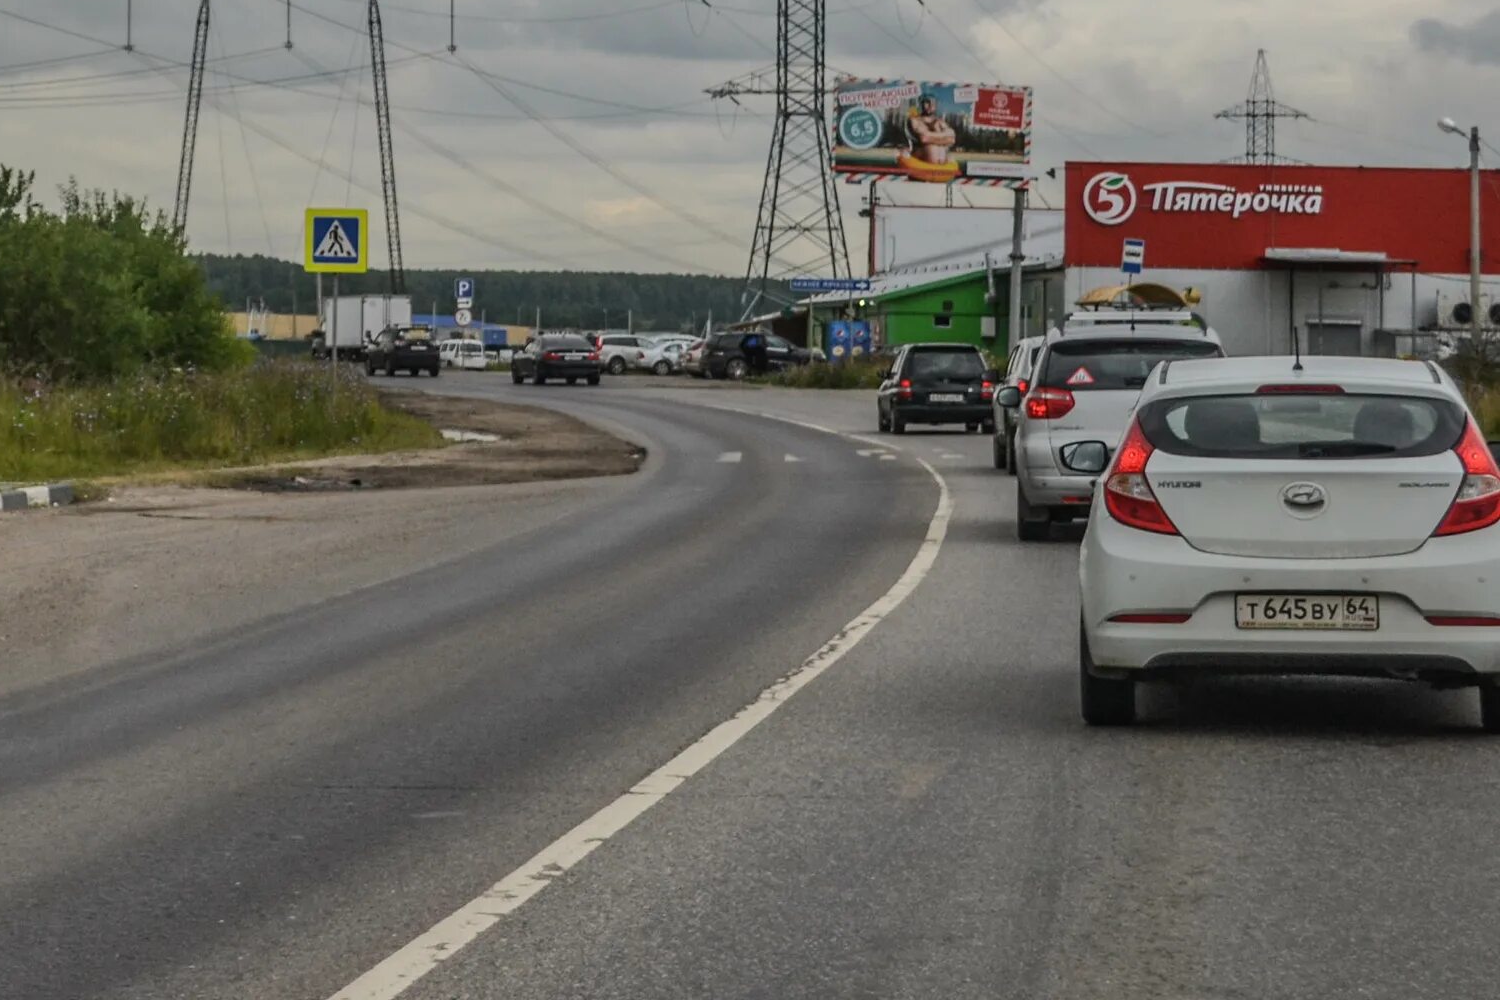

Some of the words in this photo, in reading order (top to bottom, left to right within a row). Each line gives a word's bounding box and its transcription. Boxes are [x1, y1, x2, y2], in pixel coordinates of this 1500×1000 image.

[851, 120, 874, 137] 6,5
[1259, 184, 1323, 193] УНИВЕРСАМ
[1345, 598, 1369, 615] 64
